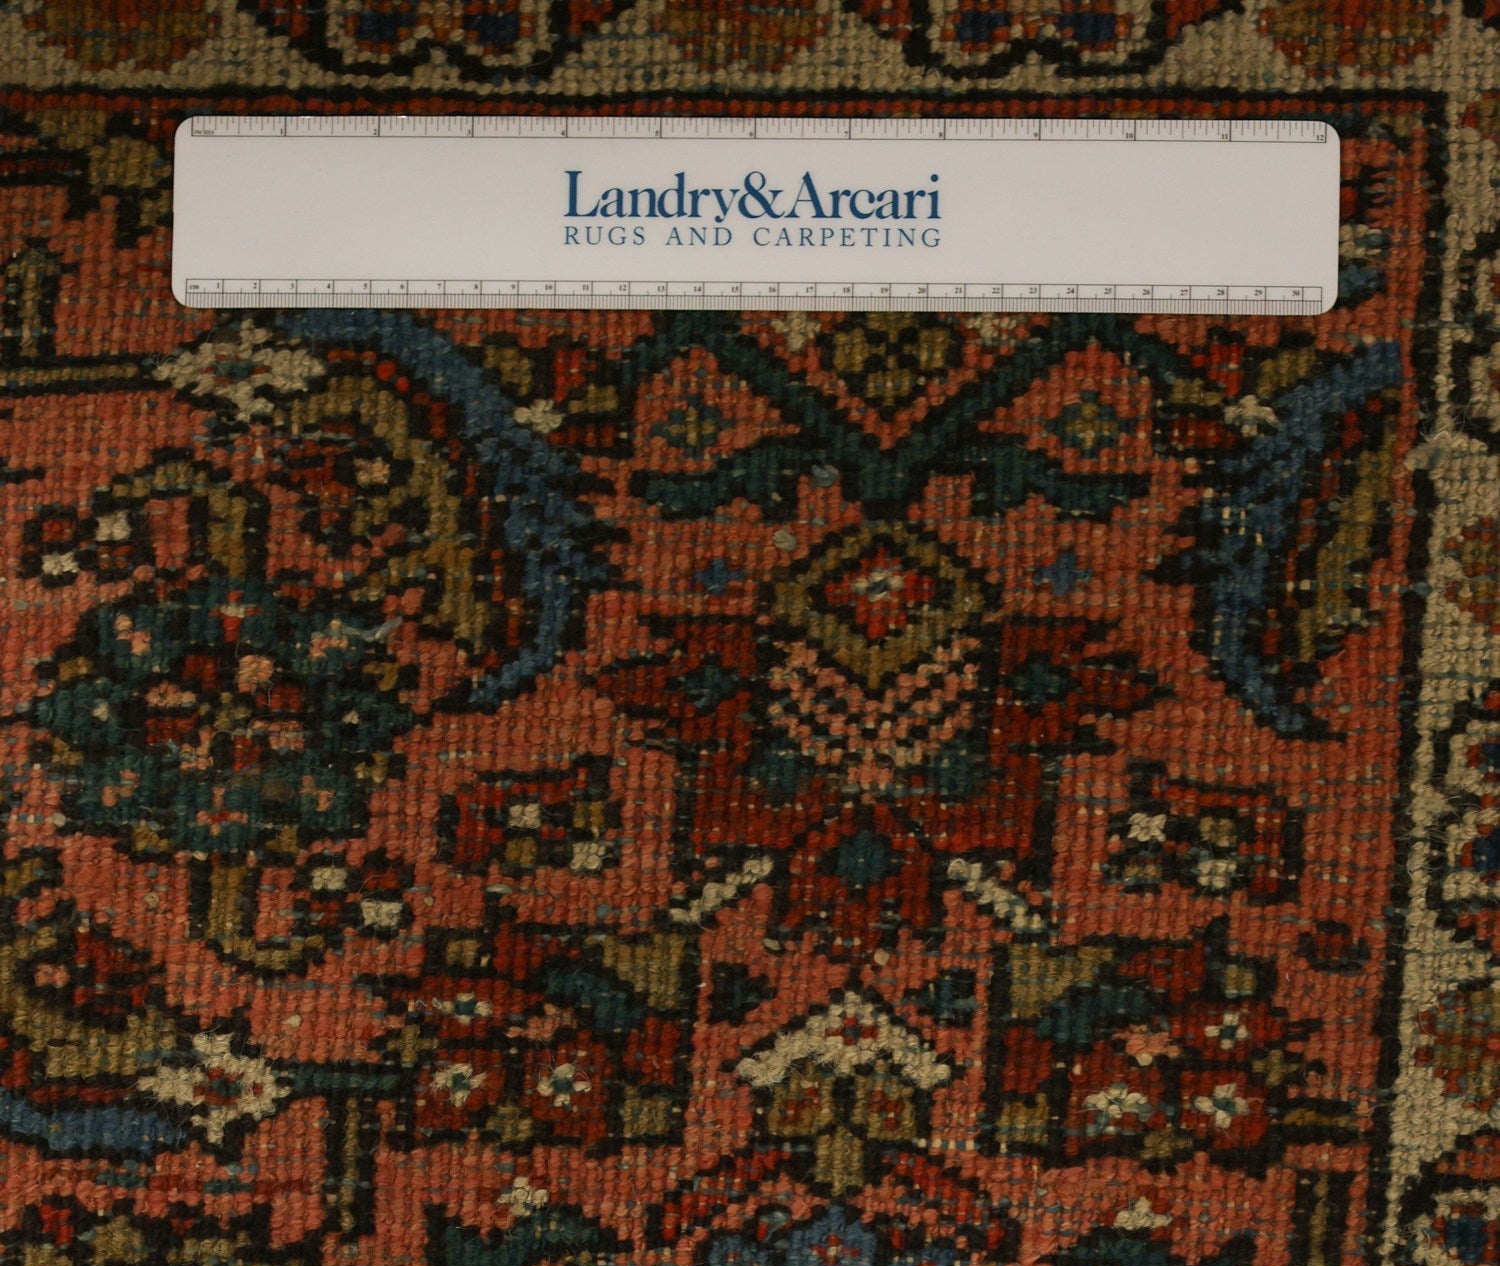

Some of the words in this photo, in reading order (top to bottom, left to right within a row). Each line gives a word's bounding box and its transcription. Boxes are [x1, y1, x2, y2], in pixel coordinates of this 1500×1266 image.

[564, 170, 942, 223] Landry&Arcari
[563, 226, 645, 246] RUGS
[665, 227, 733, 247] AND
[753, 227, 941, 248] CARPETING
[1292, 289, 1301, 297] 30
